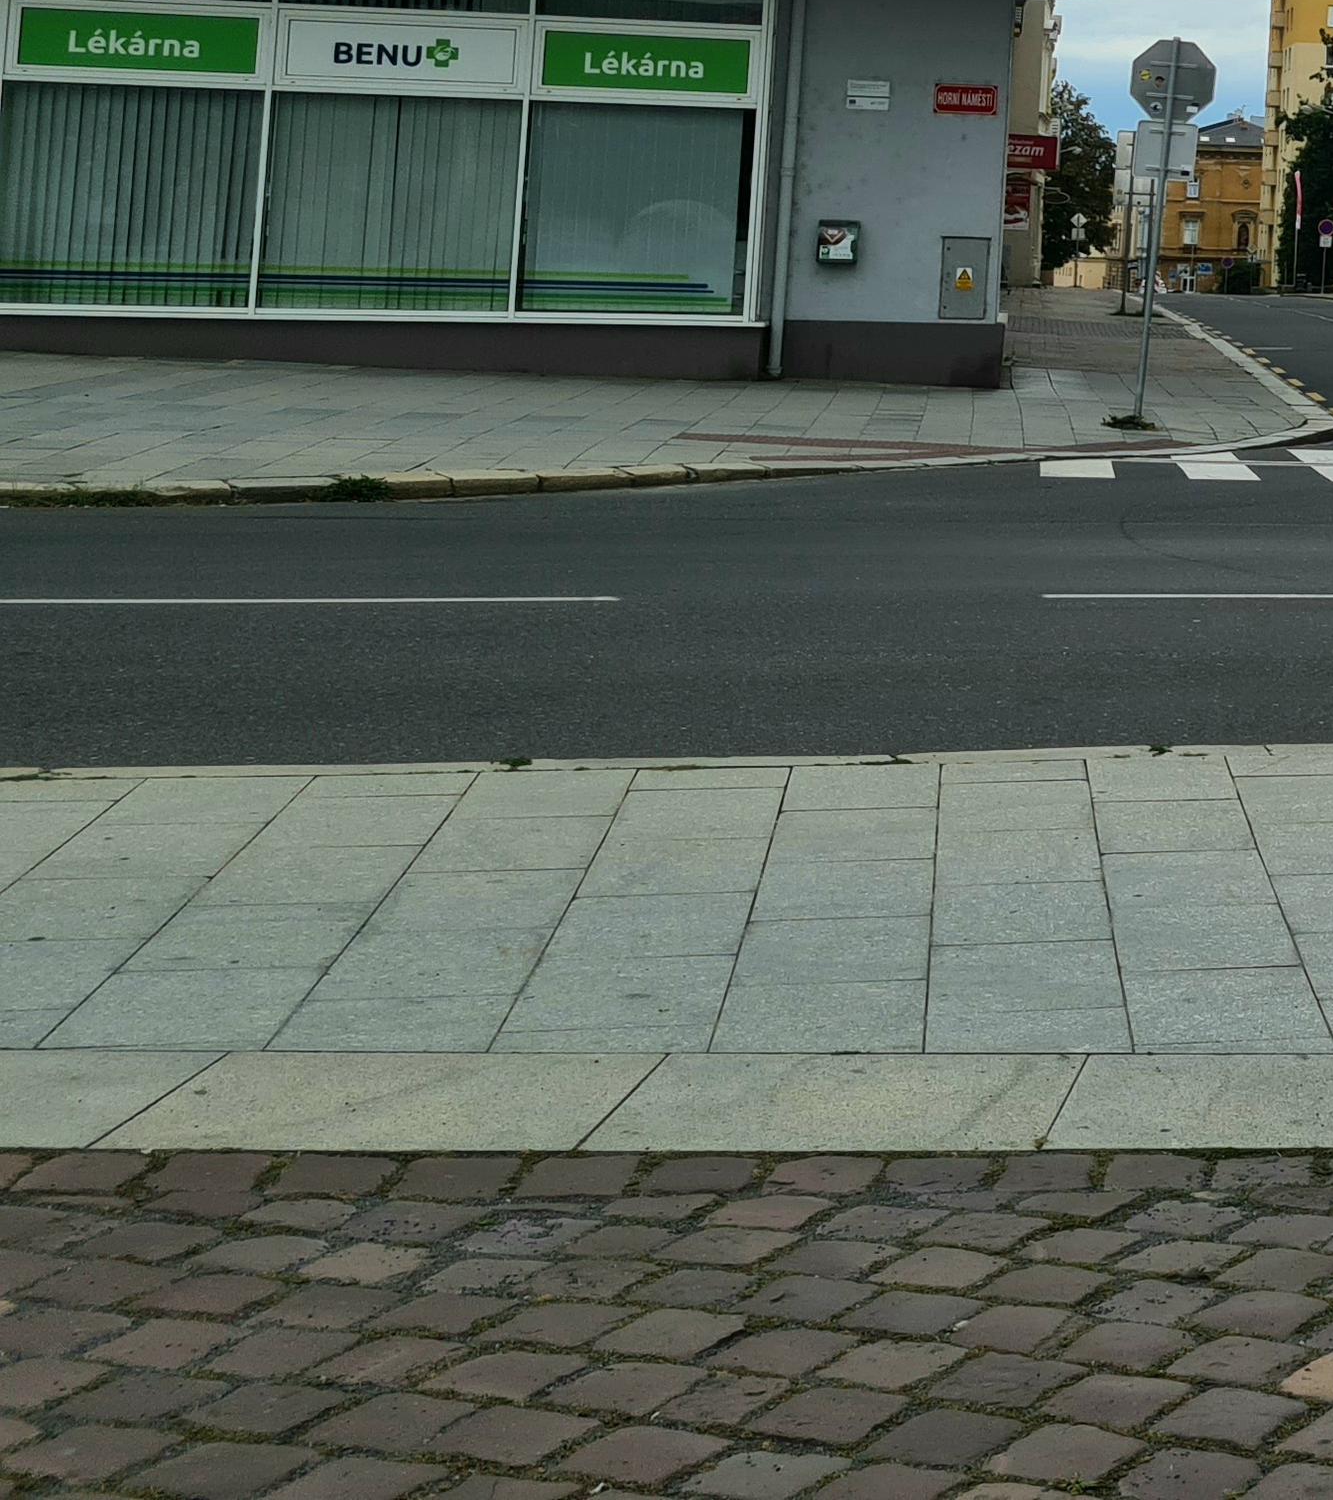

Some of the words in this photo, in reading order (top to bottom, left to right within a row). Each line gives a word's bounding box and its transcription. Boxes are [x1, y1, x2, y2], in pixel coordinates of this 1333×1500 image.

[67, 28, 201, 59] Lékárna
[333, 41, 423, 68] BENU
[583, 49, 705, 80] Lékárna
[938, 89, 960, 105] HORNÍ
[961, 90, 993, 107] NÁMĚSTÍ
[1007, 145, 1045, 157] ezam
